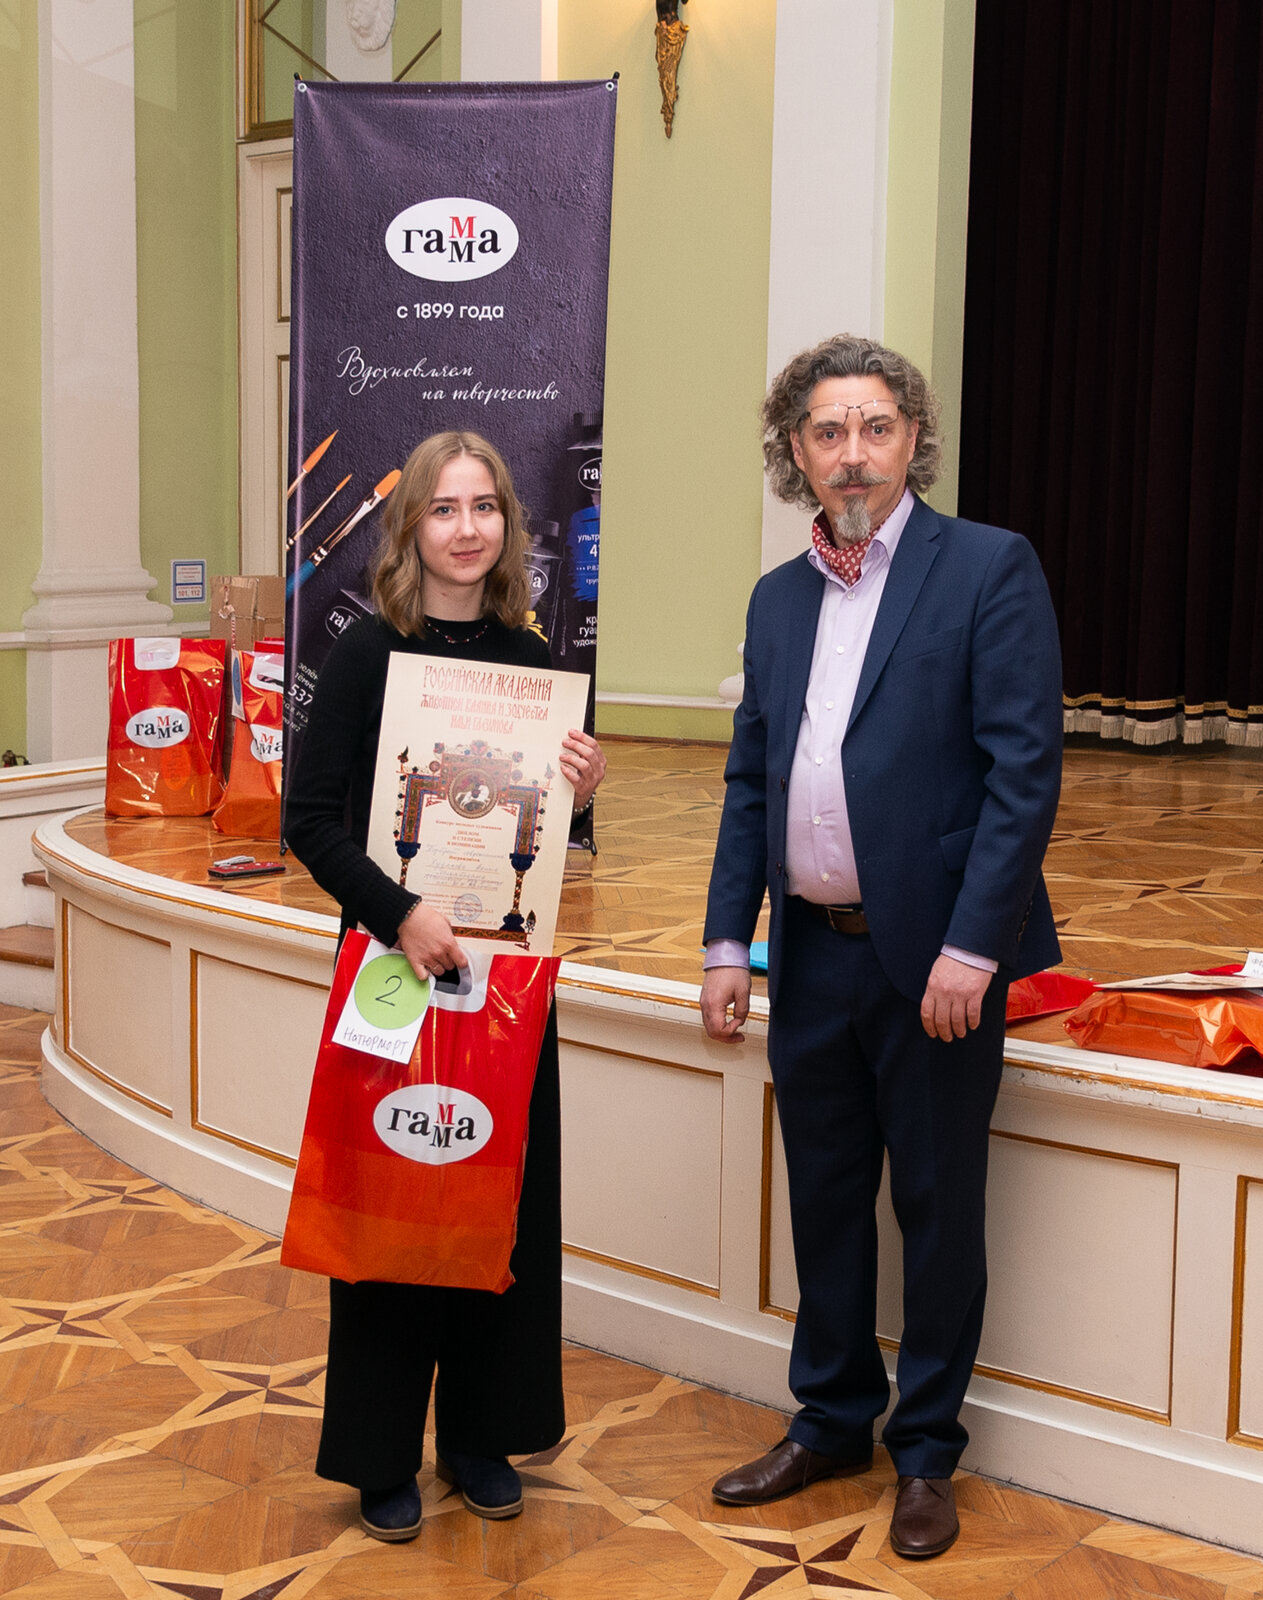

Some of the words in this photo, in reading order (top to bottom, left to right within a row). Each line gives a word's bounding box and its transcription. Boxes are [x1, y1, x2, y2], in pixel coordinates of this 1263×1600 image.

[396, 305, 408, 319] с
[413, 303, 455, 319] 1899
[460, 304, 505, 321] года
[336, 345, 474, 396] Вдохновляем
[422, 389, 446, 401] на
[452, 380, 561, 406] творчество
[287, 683, 314, 706] 537
[423, 664, 493, 696] РОССИЙСКАЯ
[493, 672, 553, 702] АКАДЕМИЯ
[374, 974, 403, 1008] 2
